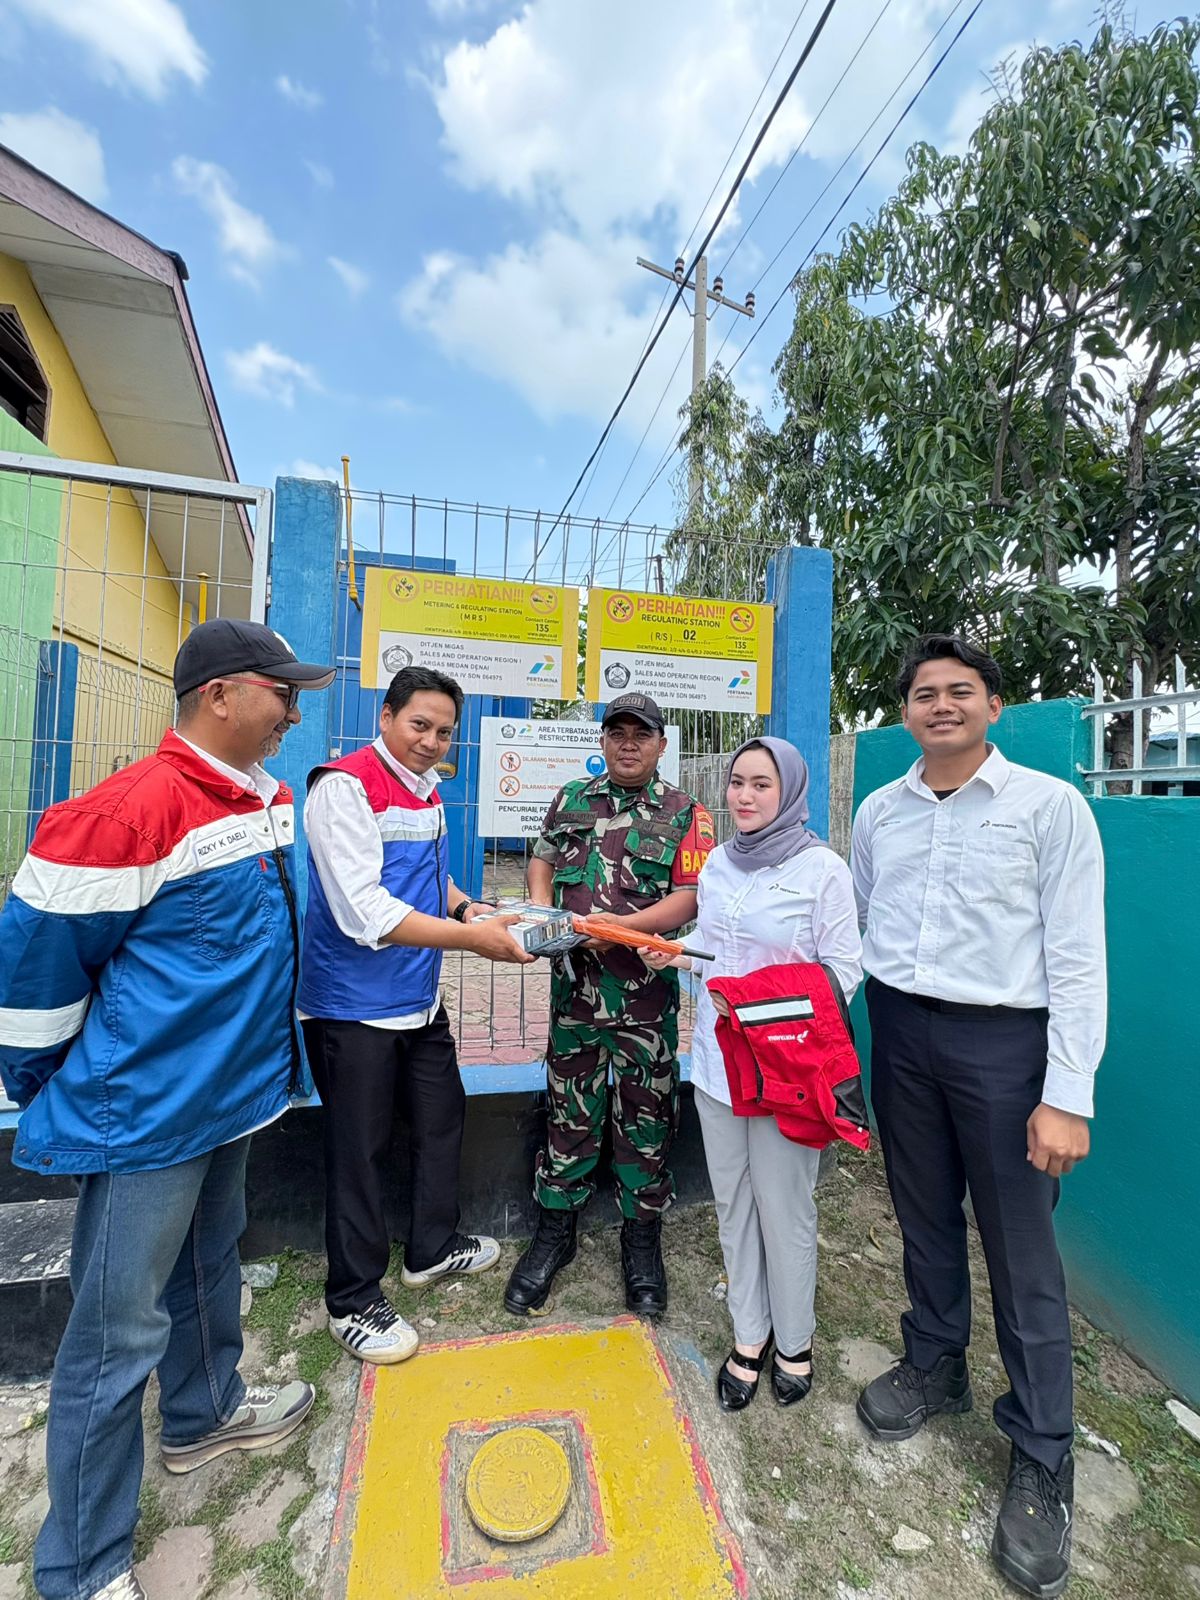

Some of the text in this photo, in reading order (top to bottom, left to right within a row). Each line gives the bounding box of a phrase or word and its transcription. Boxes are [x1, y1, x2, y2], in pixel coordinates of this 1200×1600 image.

[423, 579, 524, 603] PERHATIAN!!!
[423, 600, 455, 609] METERING
[461, 604, 497, 613] REGULATING
[499, 607, 522, 615] STATION
[637, 598, 726, 619] PERHATIAN!!!
[641, 613, 720, 628] REGULATING STATION
[536, 623, 549, 633] 135
[683, 629, 696, 641] 02
[420, 641, 443, 649] DITJEN
[735, 640, 747, 649] 135
[420, 650, 440, 658] SALES
[457, 654, 493, 663] OPERATION
[446, 662, 469, 670] MEDAN
[635, 659, 674, 669] DITJEN MIGAS
[634, 669, 653, 677] SALES
[667, 672, 699, 680] OPERATION
[699, 674, 720, 682] REGION
[634, 679, 697, 690] JARGAS MEDAN DENAI
[653, 690, 668, 698] TUBA
[556, 727, 589, 735] TERBATAS
[538, 733, 579, 742] RESTRICTED
[197, 830, 247, 856] RIZKY K DAELI
